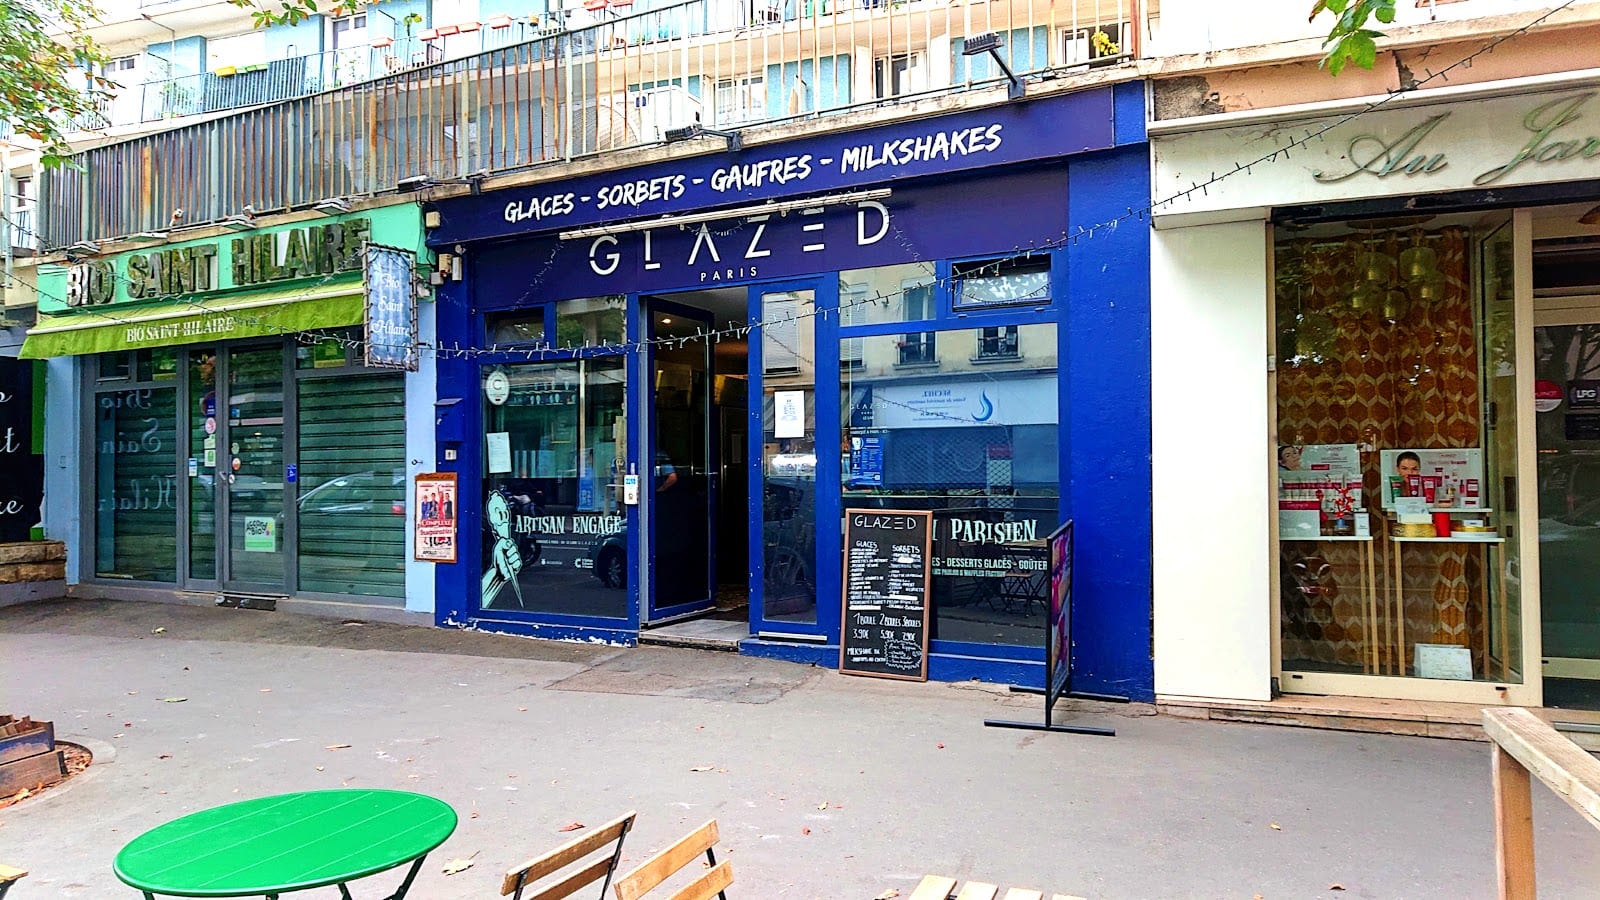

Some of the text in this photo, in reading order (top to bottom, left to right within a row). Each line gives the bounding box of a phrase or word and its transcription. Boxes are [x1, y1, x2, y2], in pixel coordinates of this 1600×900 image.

[1311, 110, 1450, 184] Au
[503, 194, 576, 223] GLACES
[595, 174, 687, 208] SORBETS
[710, 153, 814, 192] GAUFRES
[840, 124, 1004, 174] MILKSHAKES
[588, 200, 891, 277] GLAZED
[66, 217, 371, 308] BIO SAINT HILAIRE
[381, 273, 400, 289] Bio
[699, 265, 758, 283] PARIS
[378, 295, 404, 313] Saint
[126, 327, 144, 342] BIO
[370, 318, 411, 337] Hilaire
[1576, 389, 1597, 399] LPG
[515, 509, 622, 538] ARTISAN ENGAGÉ
[854, 514, 917, 531] GLAZED
[950, 518, 1038, 545] PARISIEN
[855, 540, 878, 549] GLACES
[892, 544, 921, 554] SORBETS
[947, 557, 983, 569] DESSERTS
[984, 557, 1012, 570] GLACÉS
[1018, 558, 1048, 571] GOÛTER
[860, 615, 876, 626] BOULE
